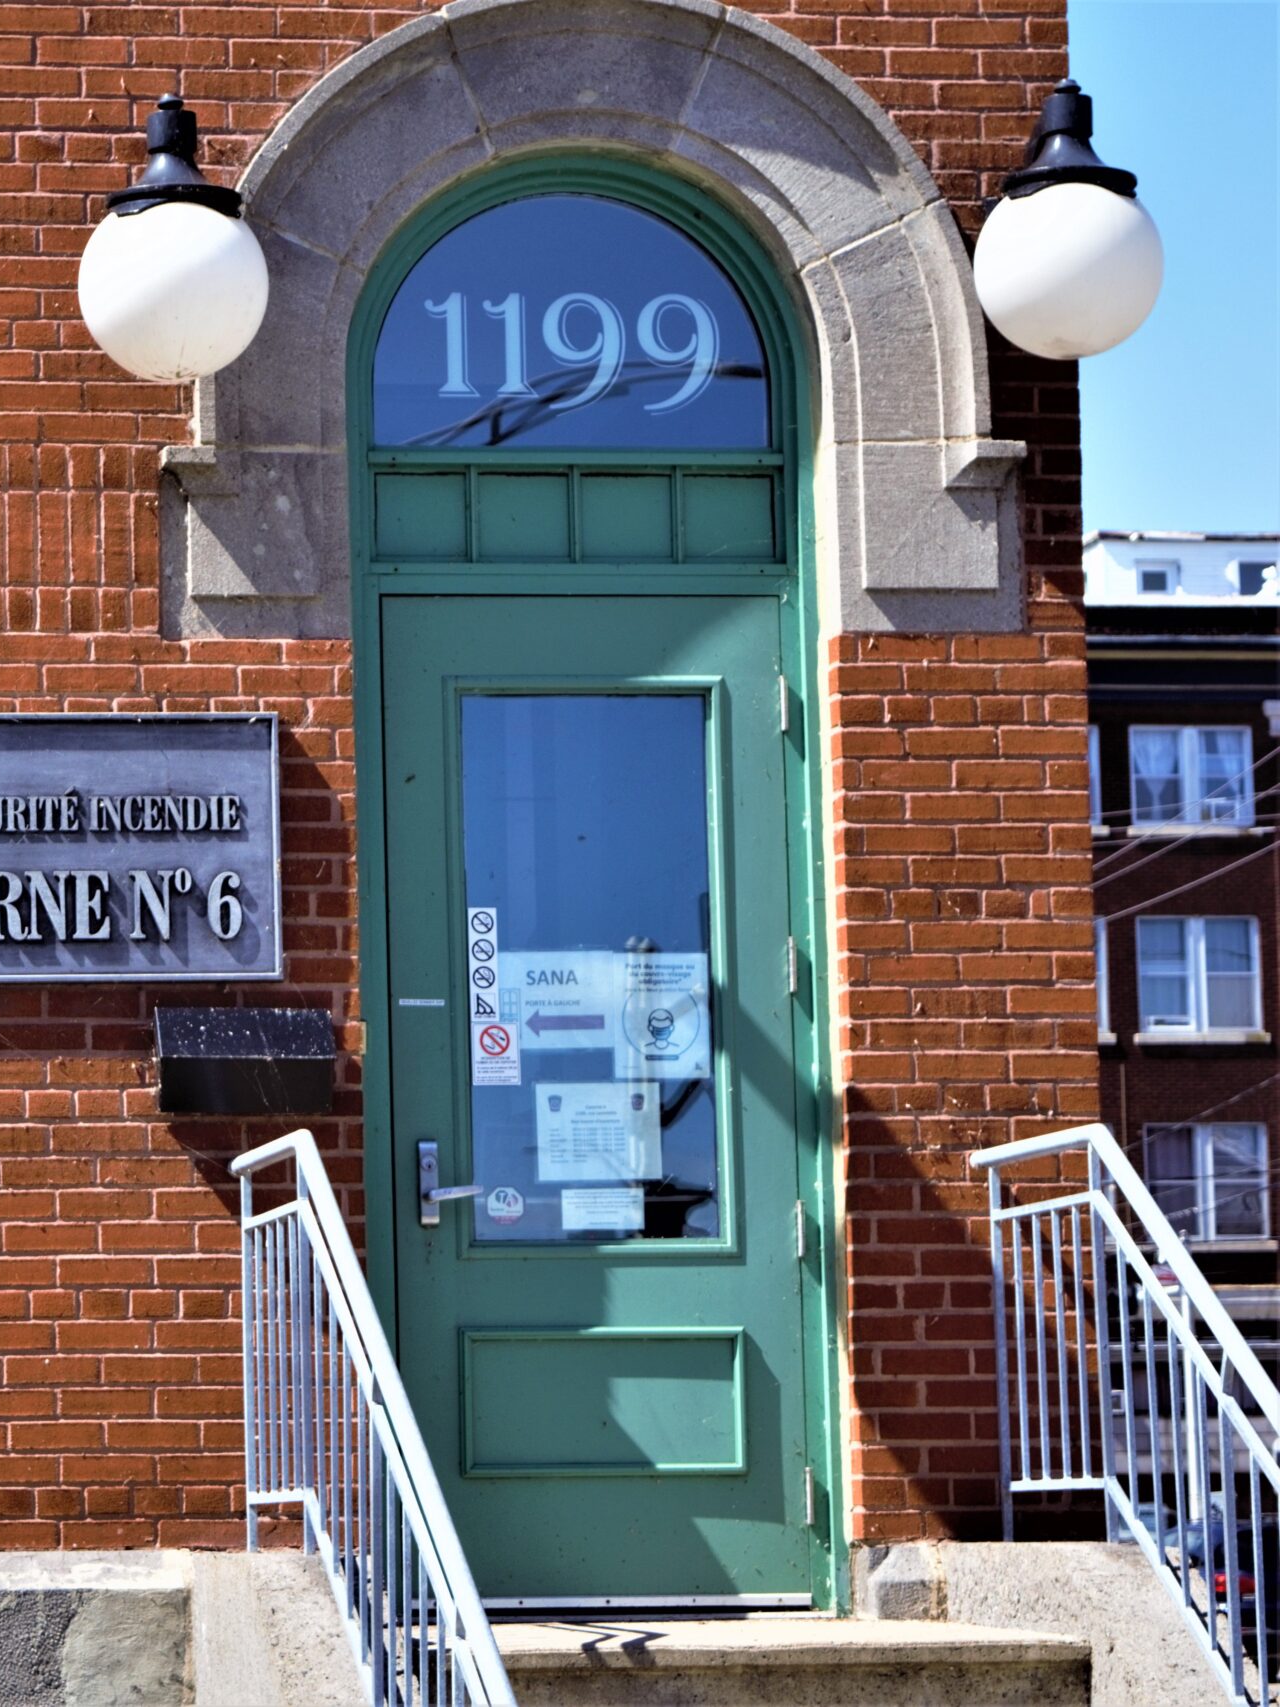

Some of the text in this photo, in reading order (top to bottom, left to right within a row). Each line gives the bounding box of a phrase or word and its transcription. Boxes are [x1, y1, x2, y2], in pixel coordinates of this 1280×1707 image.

[424, 292, 721, 416] 1199
[89, 796, 241, 832] INCENDIE
[207, 871, 243, 940] 6
[526, 970, 579, 986] SANA
